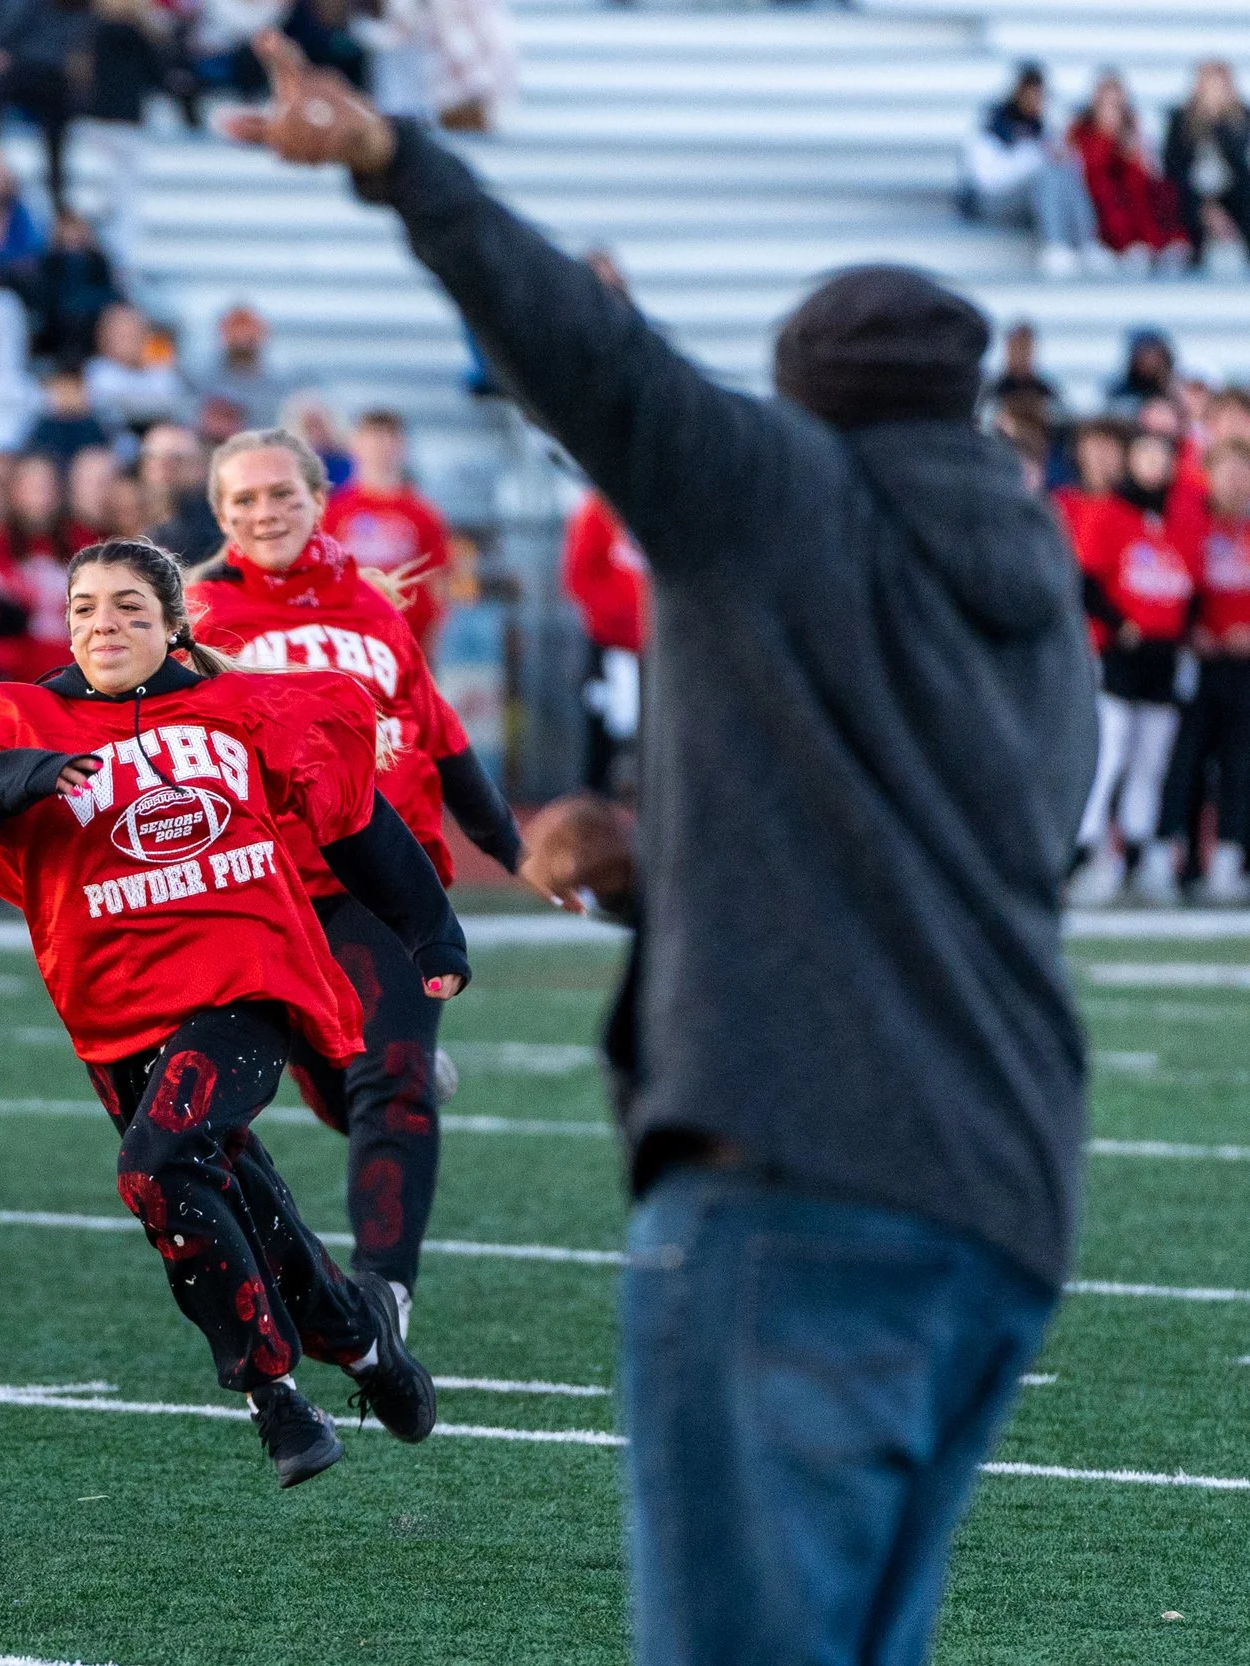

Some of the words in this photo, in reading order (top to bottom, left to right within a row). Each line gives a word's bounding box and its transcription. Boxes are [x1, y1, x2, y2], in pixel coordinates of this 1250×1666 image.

[60, 725, 248, 827] WTHS
[139, 811, 203, 836] SENIORS
[155, 826, 193, 843] 2022
[83, 860, 206, 917] POWDER
